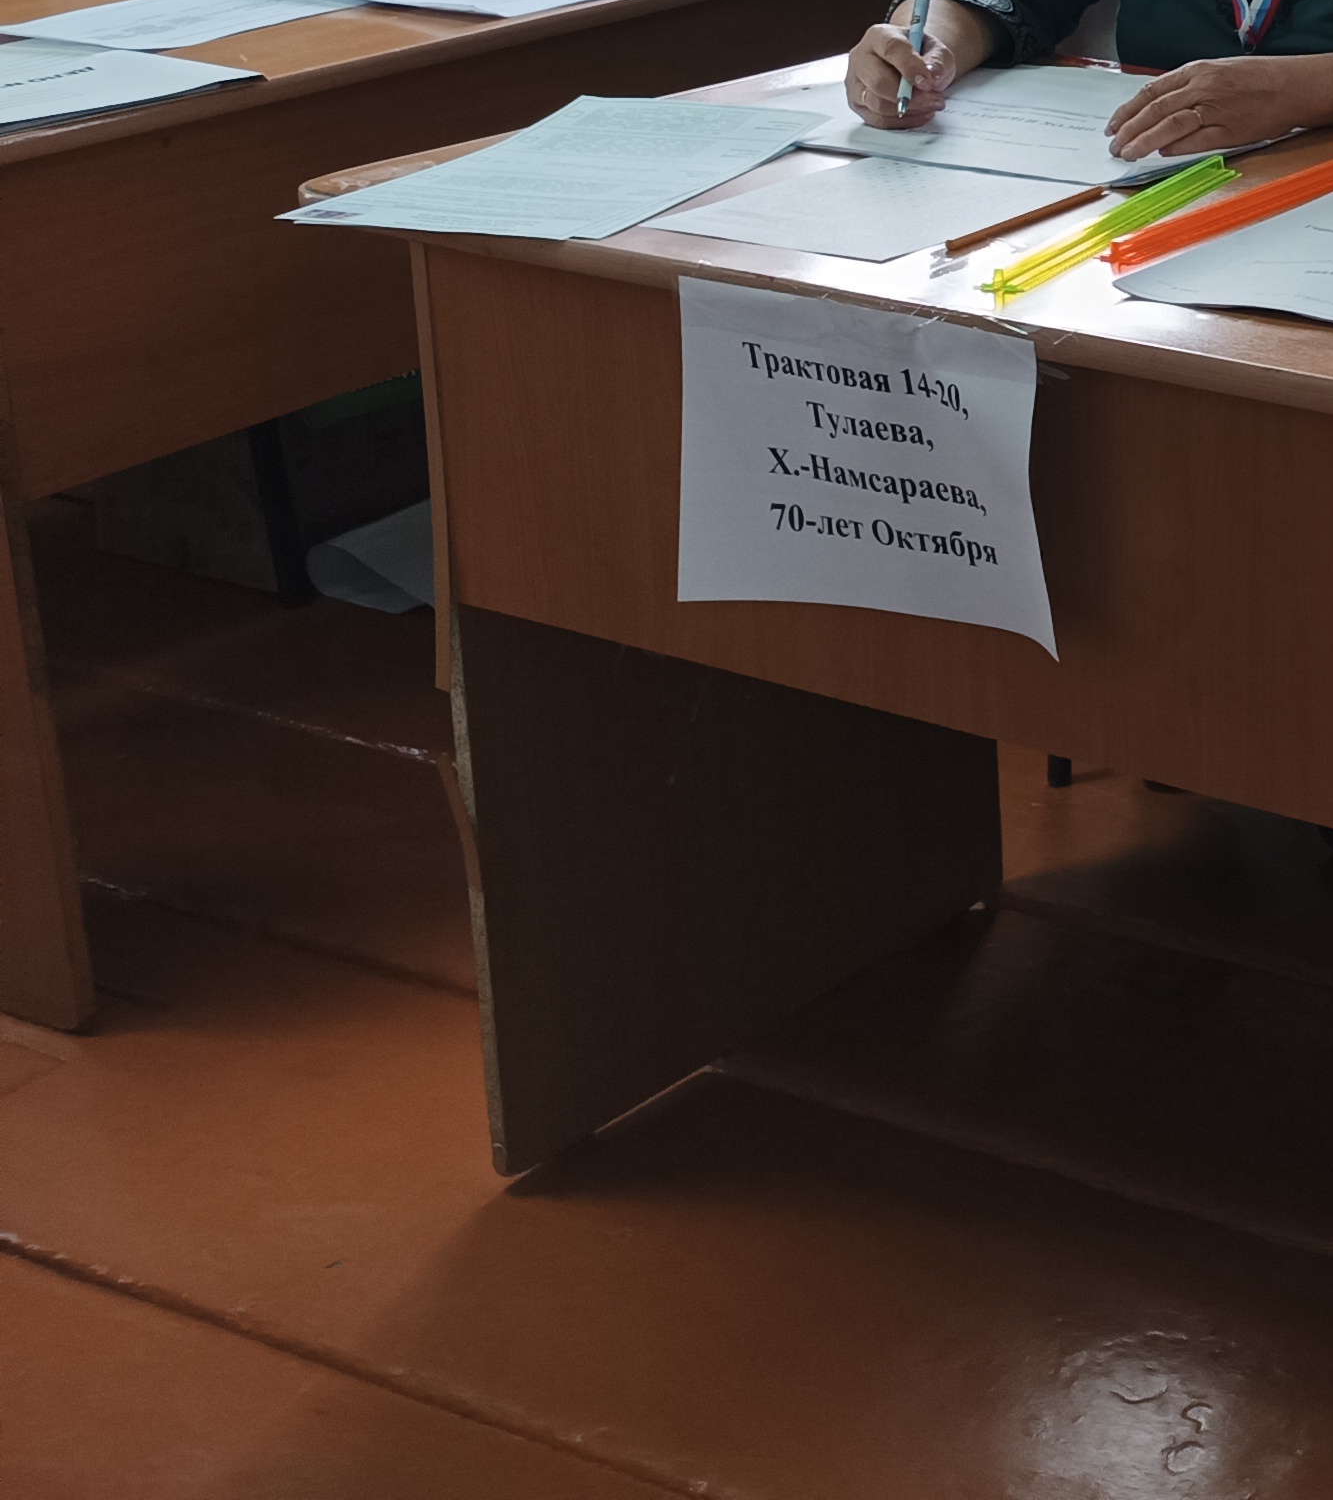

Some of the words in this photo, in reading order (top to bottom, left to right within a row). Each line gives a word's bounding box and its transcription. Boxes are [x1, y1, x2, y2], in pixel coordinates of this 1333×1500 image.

[742, 340, 891, 394] Трактовая
[900, 368, 969, 419] 14-20,
[806, 400, 934, 451] Тулаева,
[767, 446, 987, 516] Х.-Намсараева,
[770, 503, 864, 540] 70-лет
[872, 518, 999, 567] Октября
